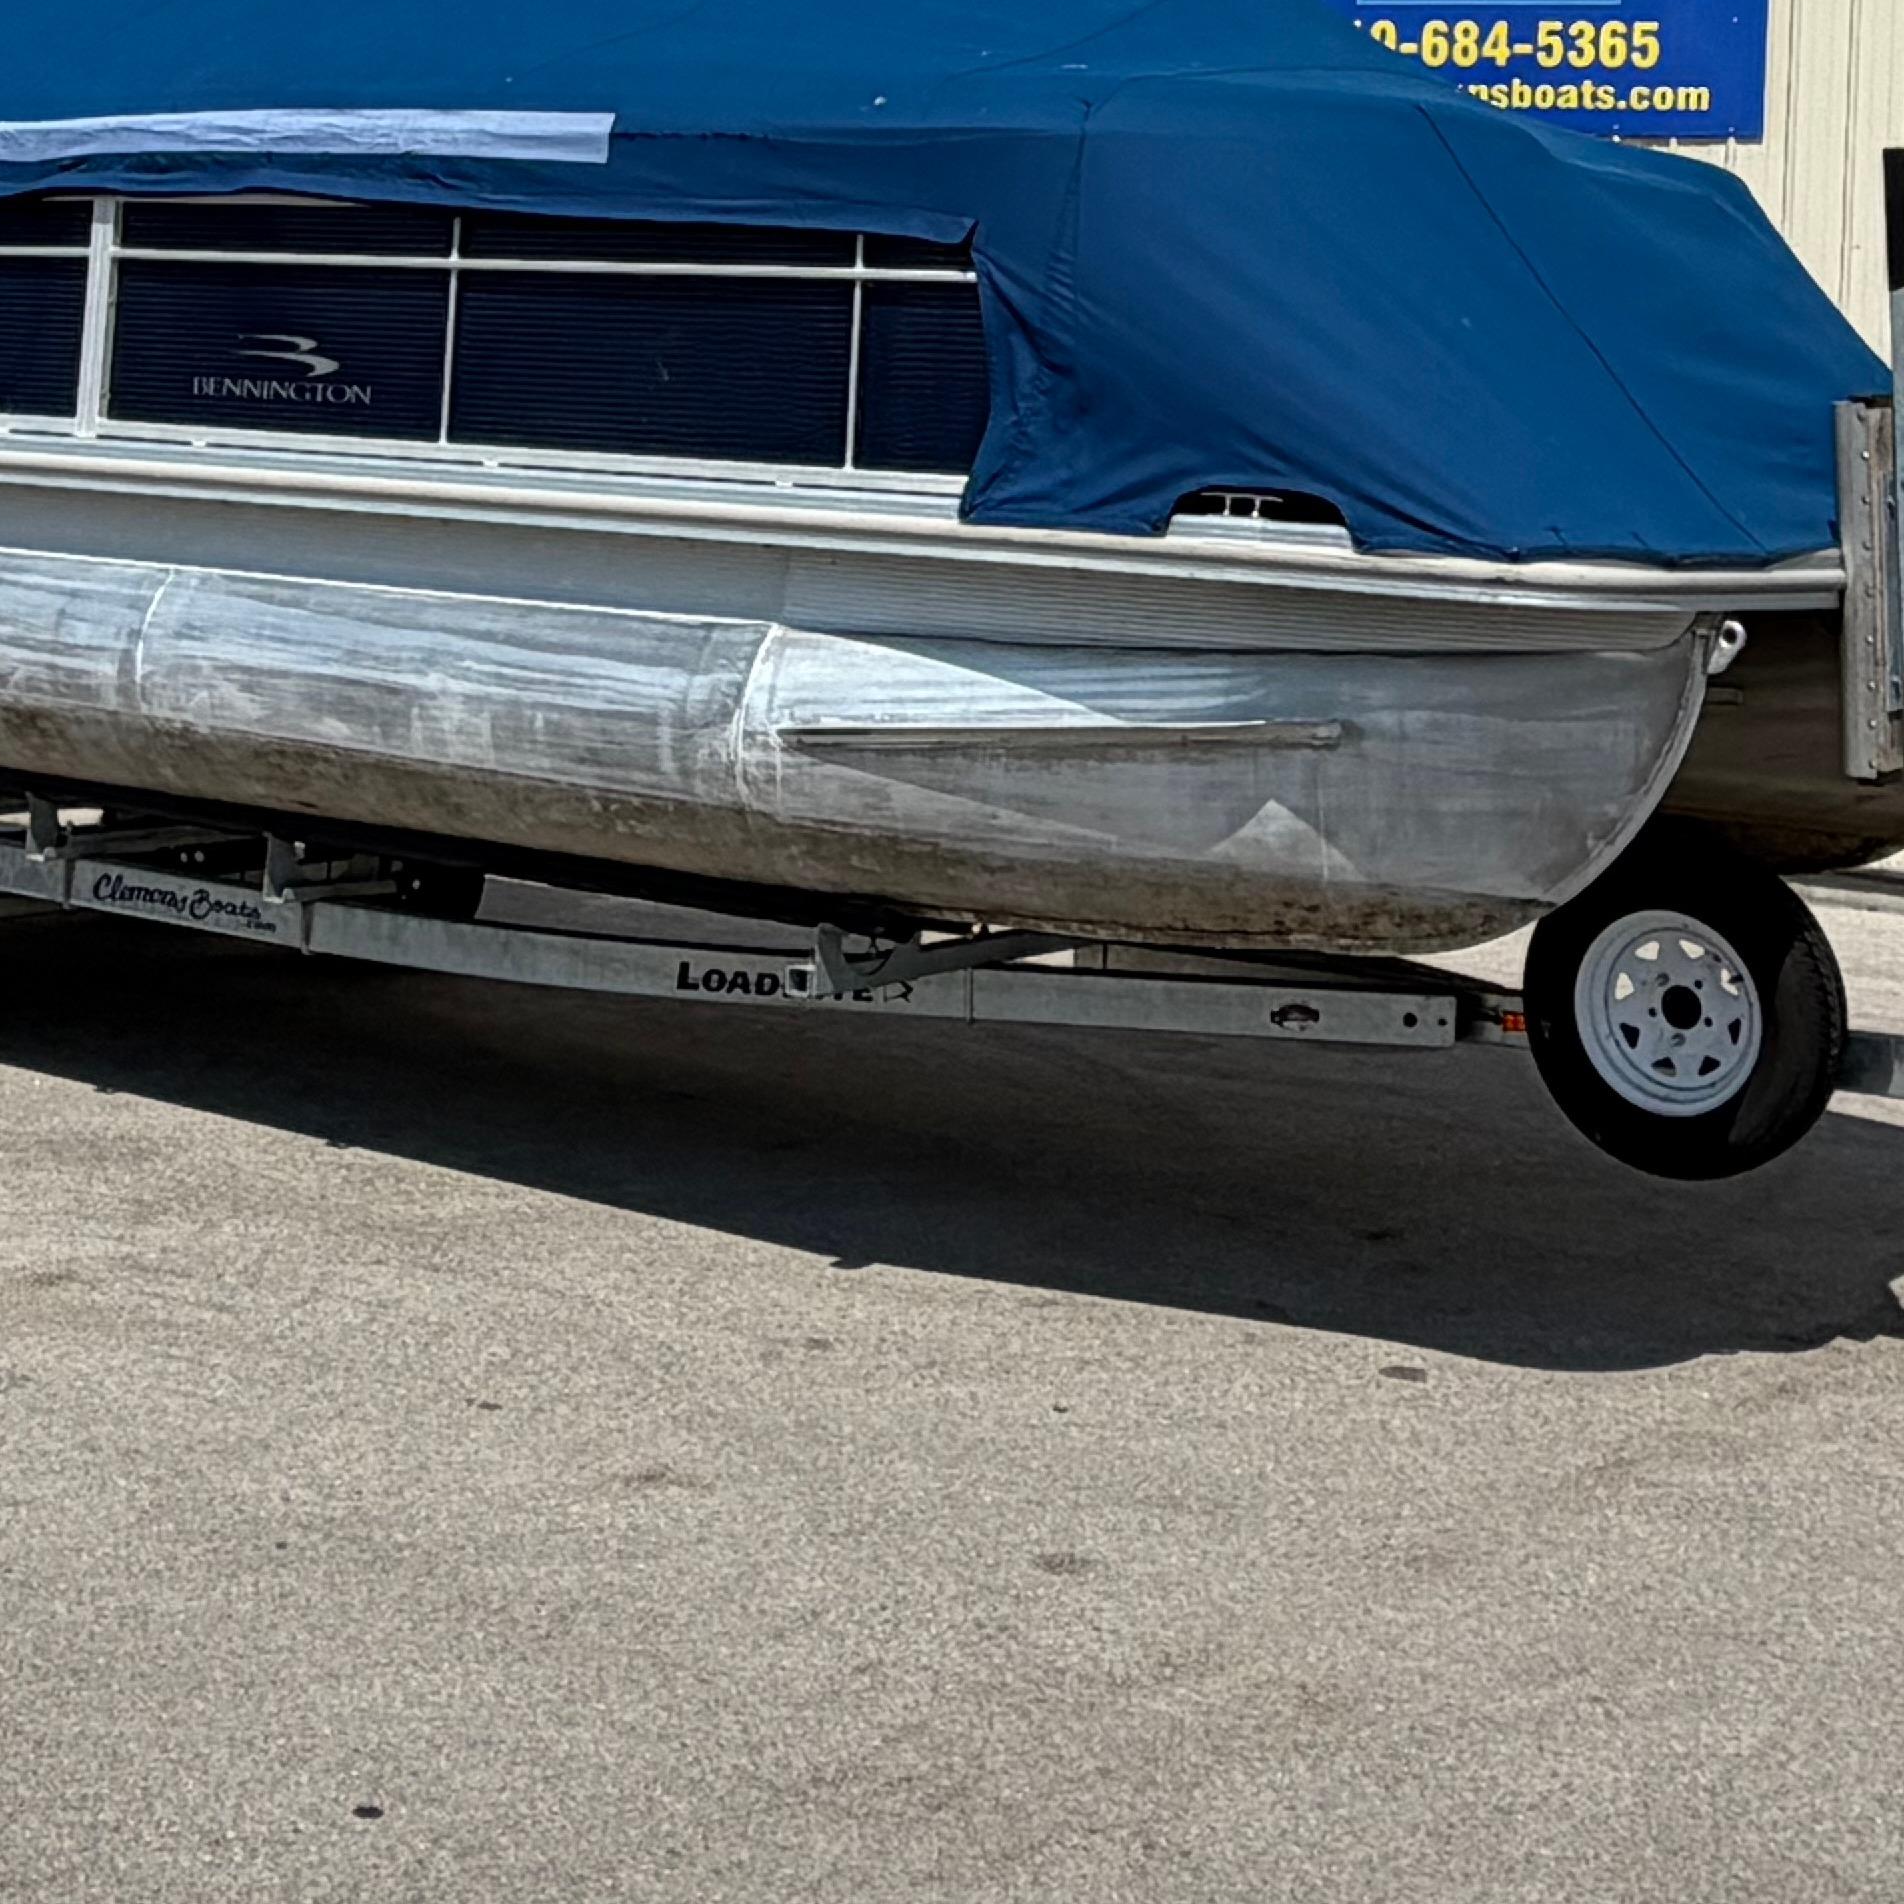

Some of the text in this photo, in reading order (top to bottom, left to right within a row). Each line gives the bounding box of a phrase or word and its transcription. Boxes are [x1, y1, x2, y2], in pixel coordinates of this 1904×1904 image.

[193, 376, 371, 405] BENNINGTON
[93, 872, 261, 920] Clemons Boats
